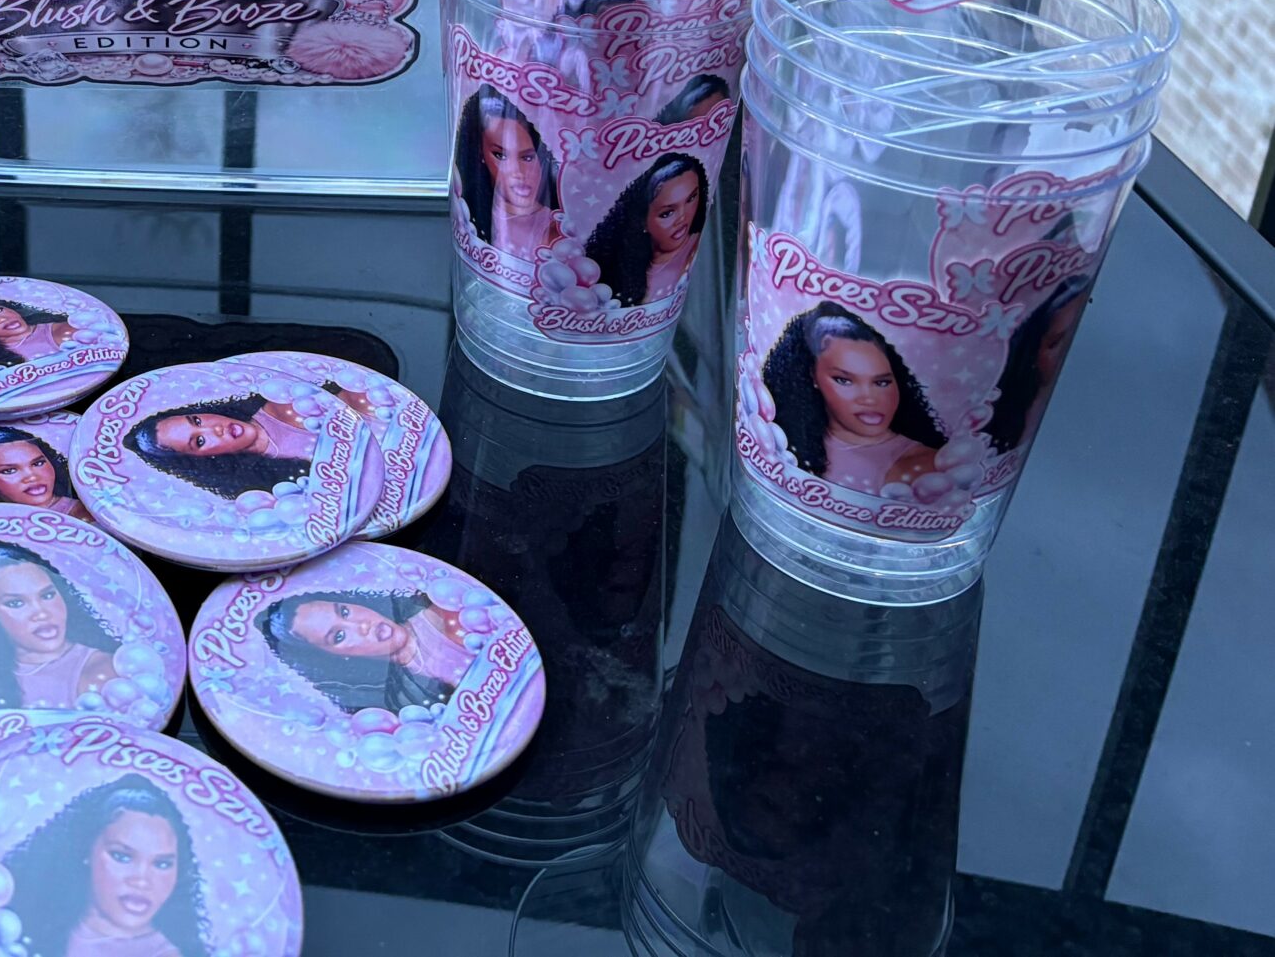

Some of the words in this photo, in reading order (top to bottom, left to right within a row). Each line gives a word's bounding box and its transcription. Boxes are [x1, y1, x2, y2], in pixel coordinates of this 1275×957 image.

[73, 35, 228, 51] EDITION
[453, 30, 520, 91] Pisces
[520, 69, 599, 118] Szn
[635, 43, 727, 96] Pisces
[604, 121, 702, 170] Pisces
[480, 248, 533, 286] Booze
[774, 241, 879, 310] Pisces
[879, 286, 978, 335] Szn
[538, 306, 605, 334] Blush
[607, 318, 621, 334] &
[619, 308, 667, 336] Booze
[6, 373, 19, 388] &
[15, 360, 71, 383] Booze
[98, 378, 150, 418] Szn
[77, 417, 130, 485] Pisces
[317, 439, 350, 485] Booze
[384, 429, 419, 472] Booze
[323, 481, 342, 494] &
[389, 468, 407, 481] &
[738, 428, 785, 487] Blush
[785, 477, 801, 494] &
[800, 479, 872, 522] Booze
[875, 503, 962, 531] Edition
[27, 512, 104, 547] Szn
[305, 493, 342, 547] Blush
[193, 586, 264, 669] Pisces
[458, 669, 507, 724] Booze
[459, 715, 480, 732] &
[62, 721, 193, 784] Pisces
[184, 767, 272, 837] Szn
[422, 725, 474, 793] Blush
